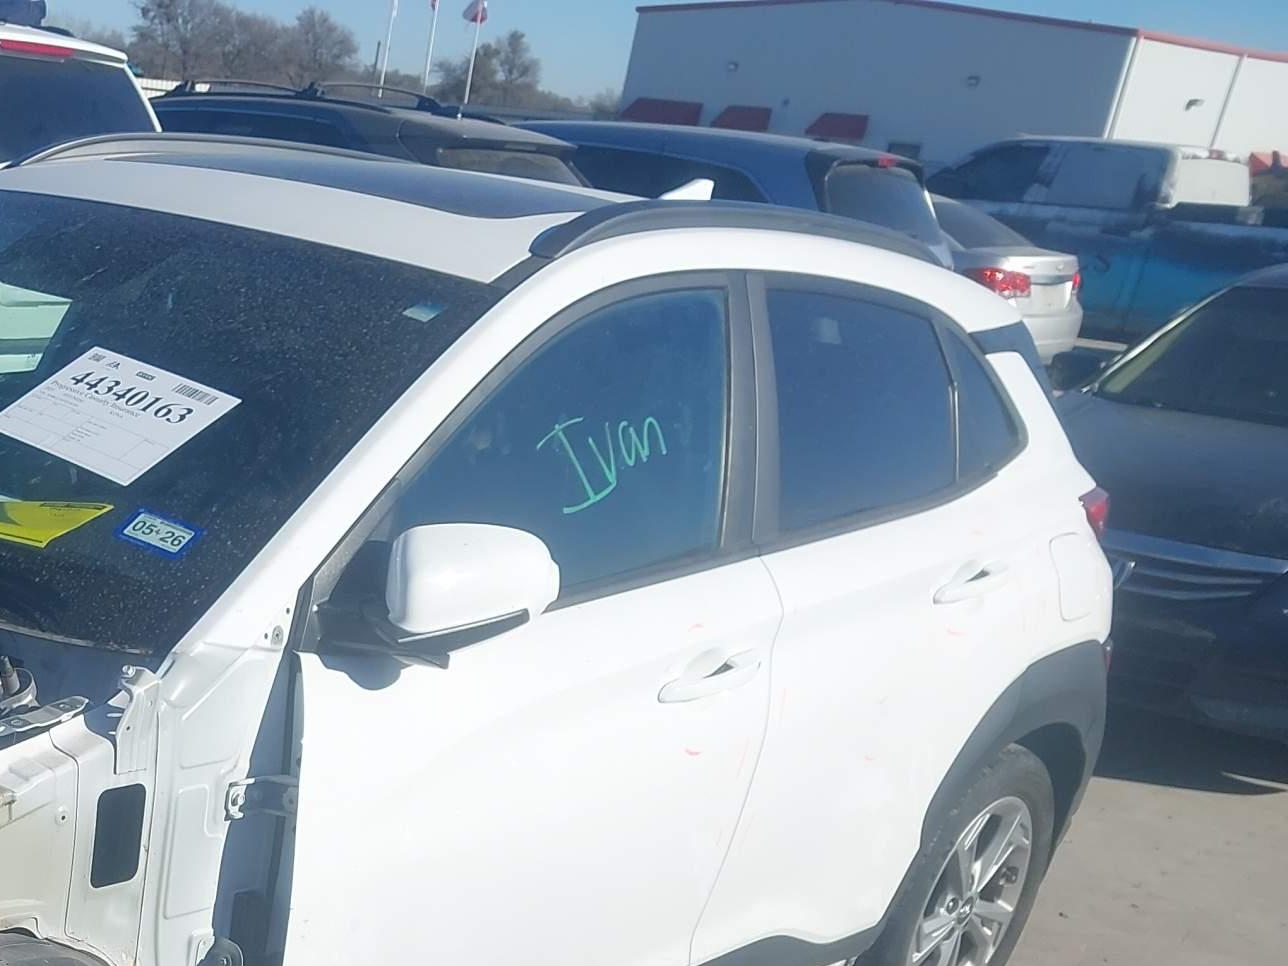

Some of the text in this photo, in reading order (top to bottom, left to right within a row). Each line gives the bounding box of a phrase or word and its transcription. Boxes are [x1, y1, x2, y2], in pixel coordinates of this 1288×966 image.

[70, 371, 194, 424] 44340163
[536, 416, 667, 514] Ivan
[132, 520, 158, 535] 05
[159, 530, 186, 547] 26
